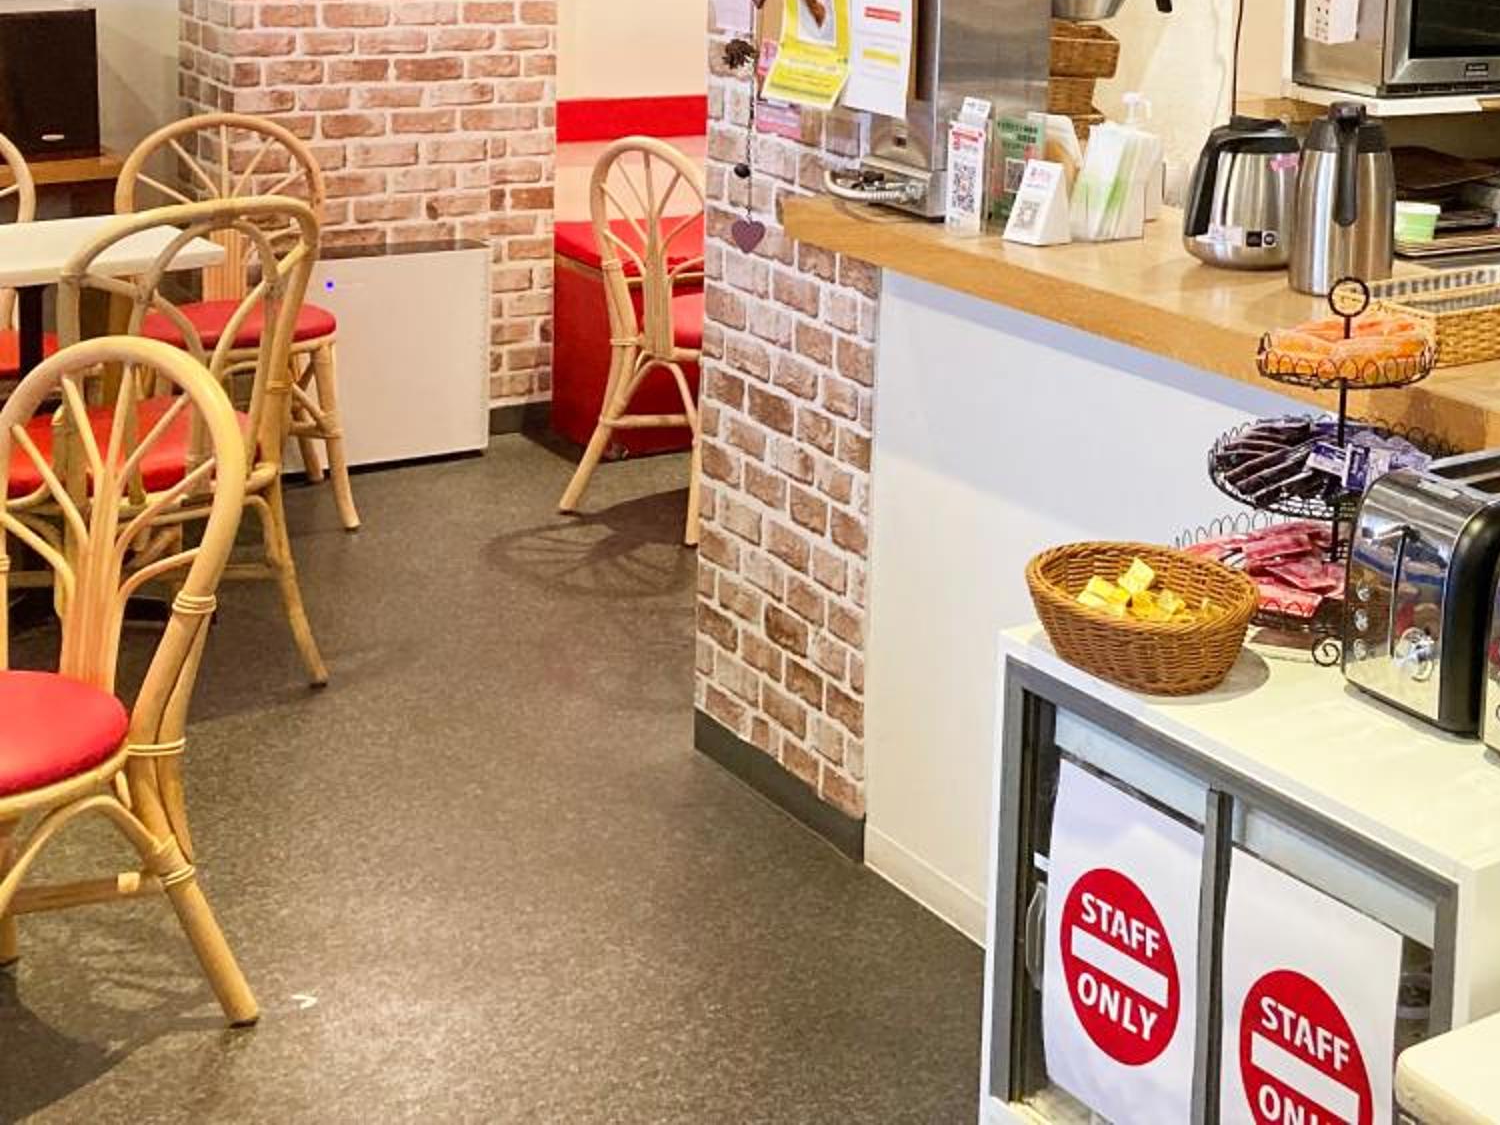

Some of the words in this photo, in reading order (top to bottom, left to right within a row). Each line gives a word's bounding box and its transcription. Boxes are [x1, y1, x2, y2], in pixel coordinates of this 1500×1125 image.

[1080, 891, 1160, 960] STAFF
[1076, 973, 1160, 1043] ONLY
[1259, 994, 1351, 1072] STAFF
[1257, 1084, 1332, 1125] ON
